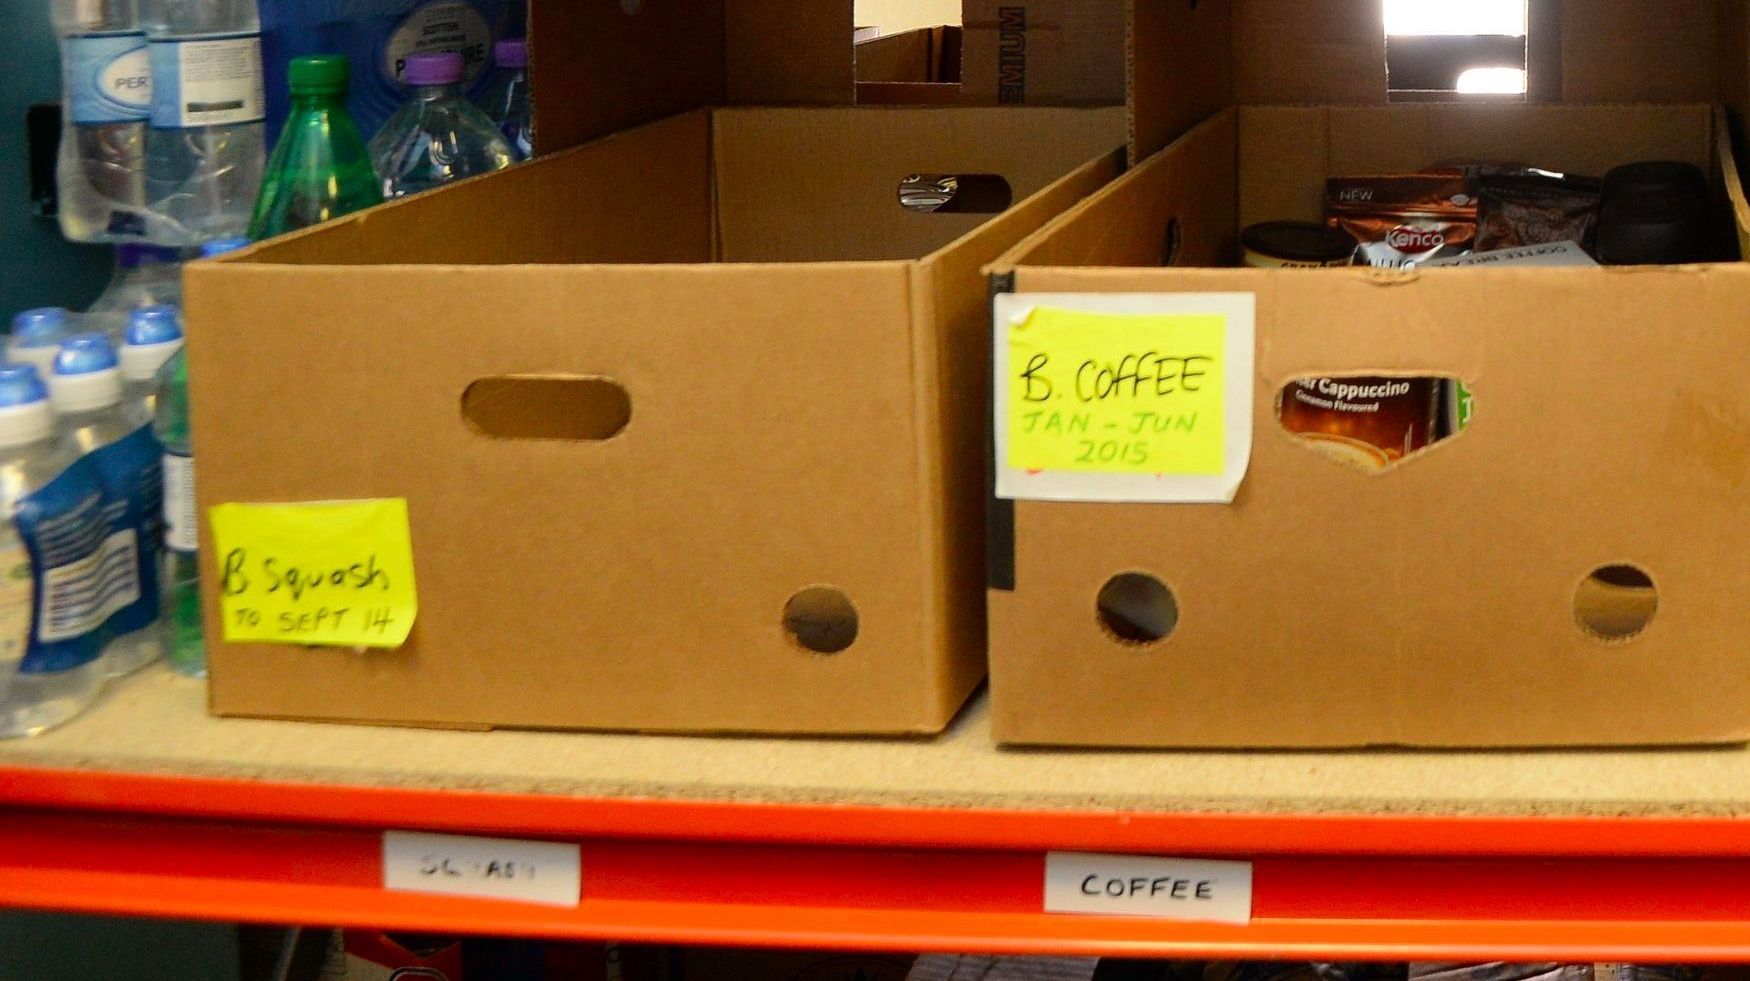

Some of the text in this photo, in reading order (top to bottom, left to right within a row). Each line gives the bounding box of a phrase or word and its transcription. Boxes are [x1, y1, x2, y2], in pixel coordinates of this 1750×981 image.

[1340, 189, 1373, 200] NEW
[1386, 229, 1443, 247] Kenco
[1076, 351, 1213, 402] COFFEE
[1318, 378, 1410, 399] Cappuccino
[1022, 412, 1090, 433] JAN
[1128, 412, 1197, 433] JUN
[1075, 440, 1150, 464] 2015
[222, 549, 390, 599] B Squash
[236, 608, 394, 632] TO SEPT 14
[1080, 874, 1215, 901] COFFEE
